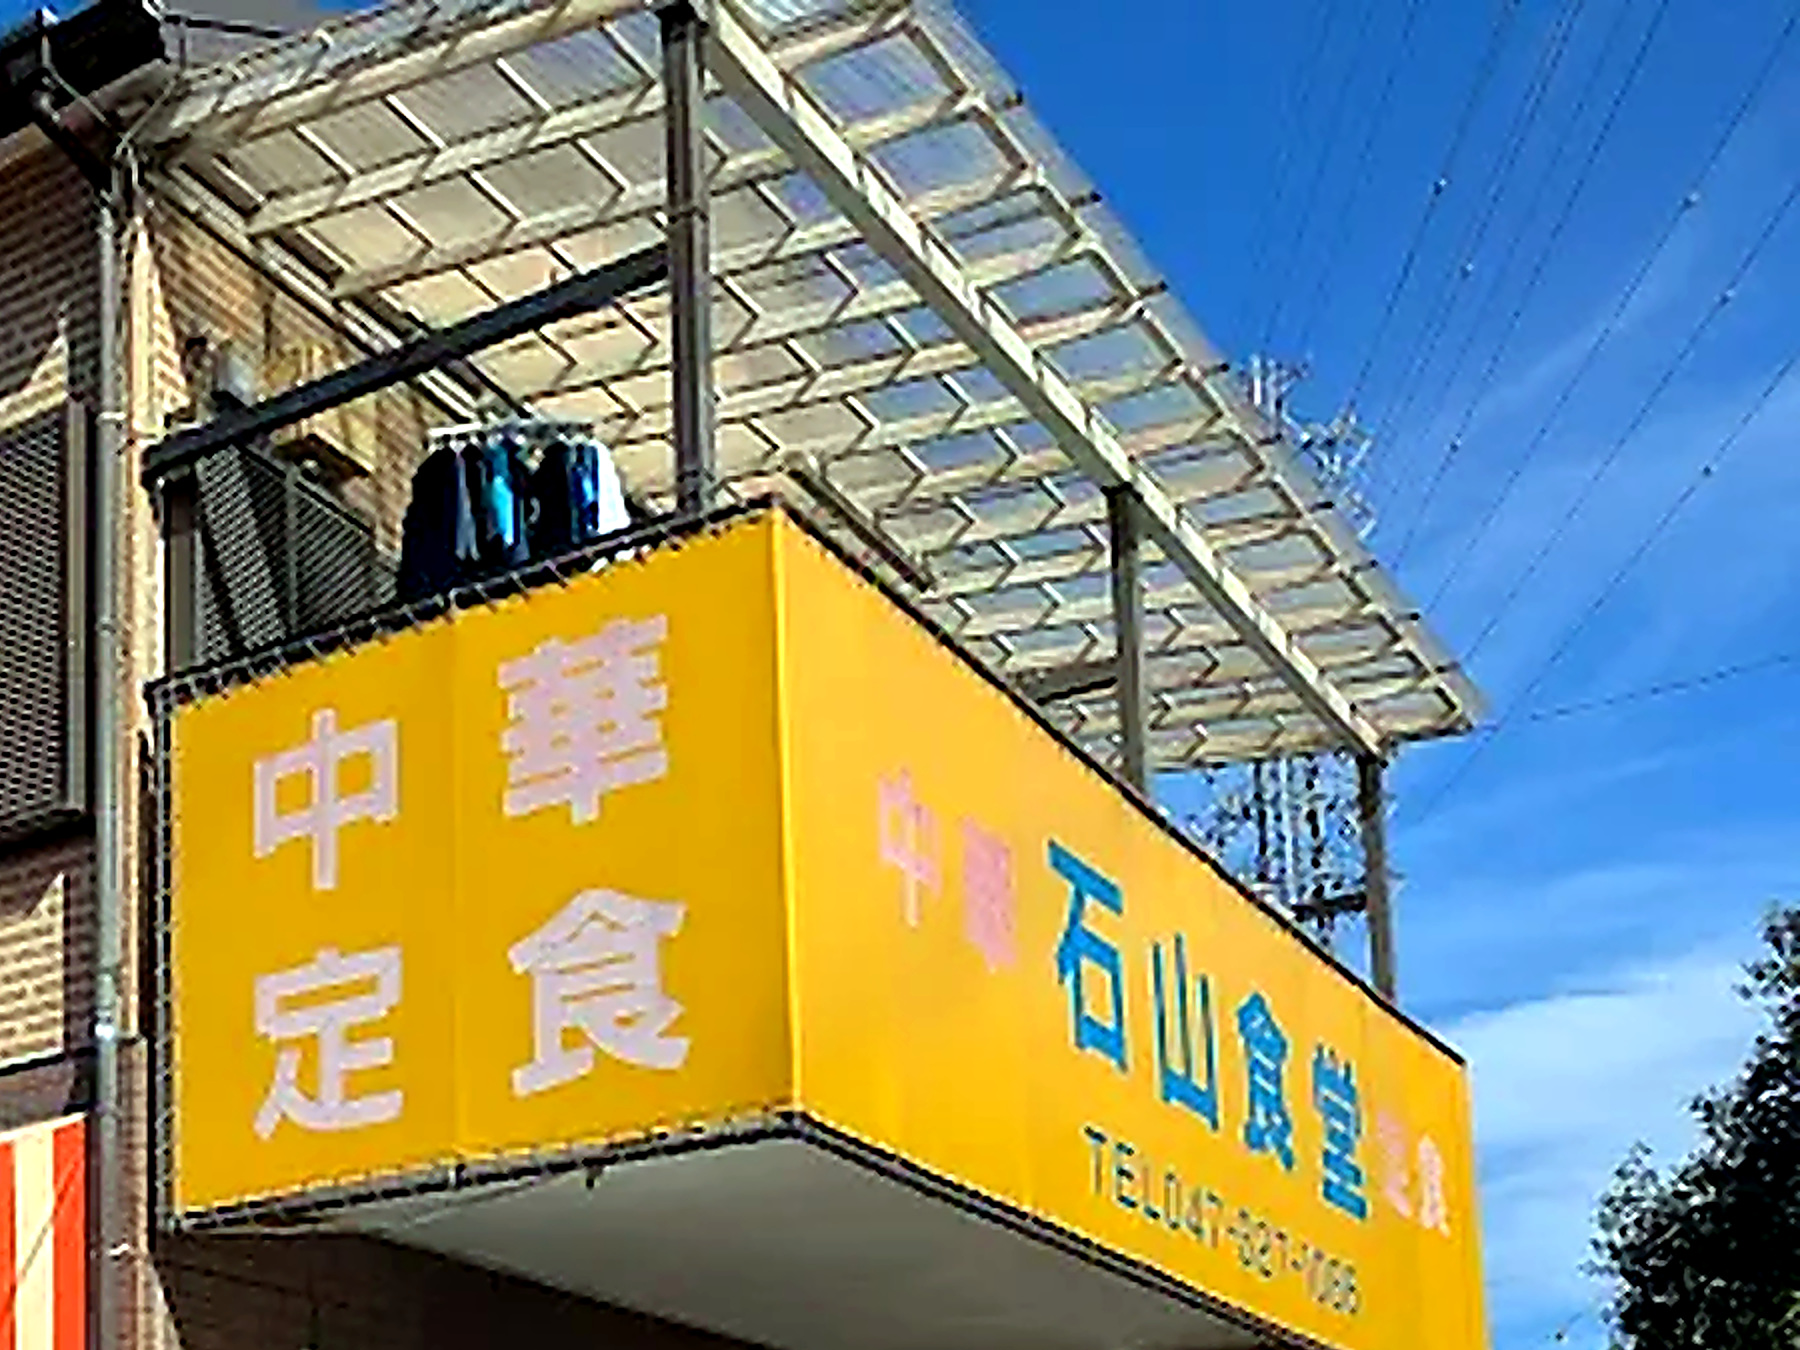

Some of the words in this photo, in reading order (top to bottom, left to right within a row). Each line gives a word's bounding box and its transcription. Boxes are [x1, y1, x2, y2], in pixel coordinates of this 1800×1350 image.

[252, 613, 670, 890] 中華
[252, 886, 690, 1141] 定食
[1046, 837, 1370, 1222] 石山食堂
